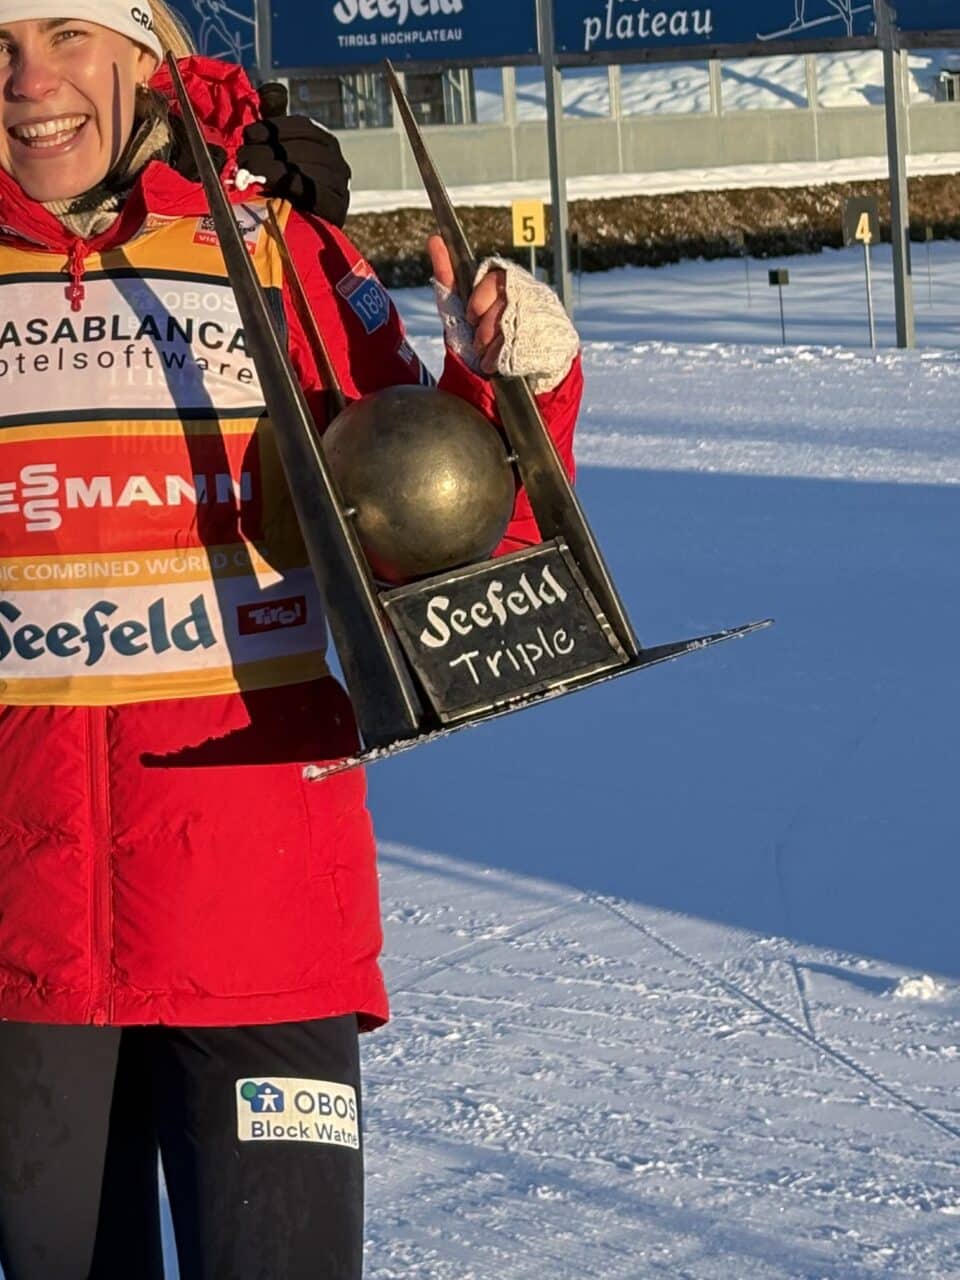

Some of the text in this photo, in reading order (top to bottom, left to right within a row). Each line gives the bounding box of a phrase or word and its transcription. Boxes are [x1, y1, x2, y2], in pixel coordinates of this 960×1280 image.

[338, 28, 464, 48] TIROLS HOCHPLATEAU
[582, 3, 713, 51] plateau
[522, 215, 536, 244] 5
[855, 212, 872, 243] 4
[23, 560, 140, 582] COMBINED
[420, 565, 569, 648] Seefeld
[449, 626, 576, 685] Triple
[294, 1090, 356, 1122] OBOS
[251, 1120, 311, 1139] Block
